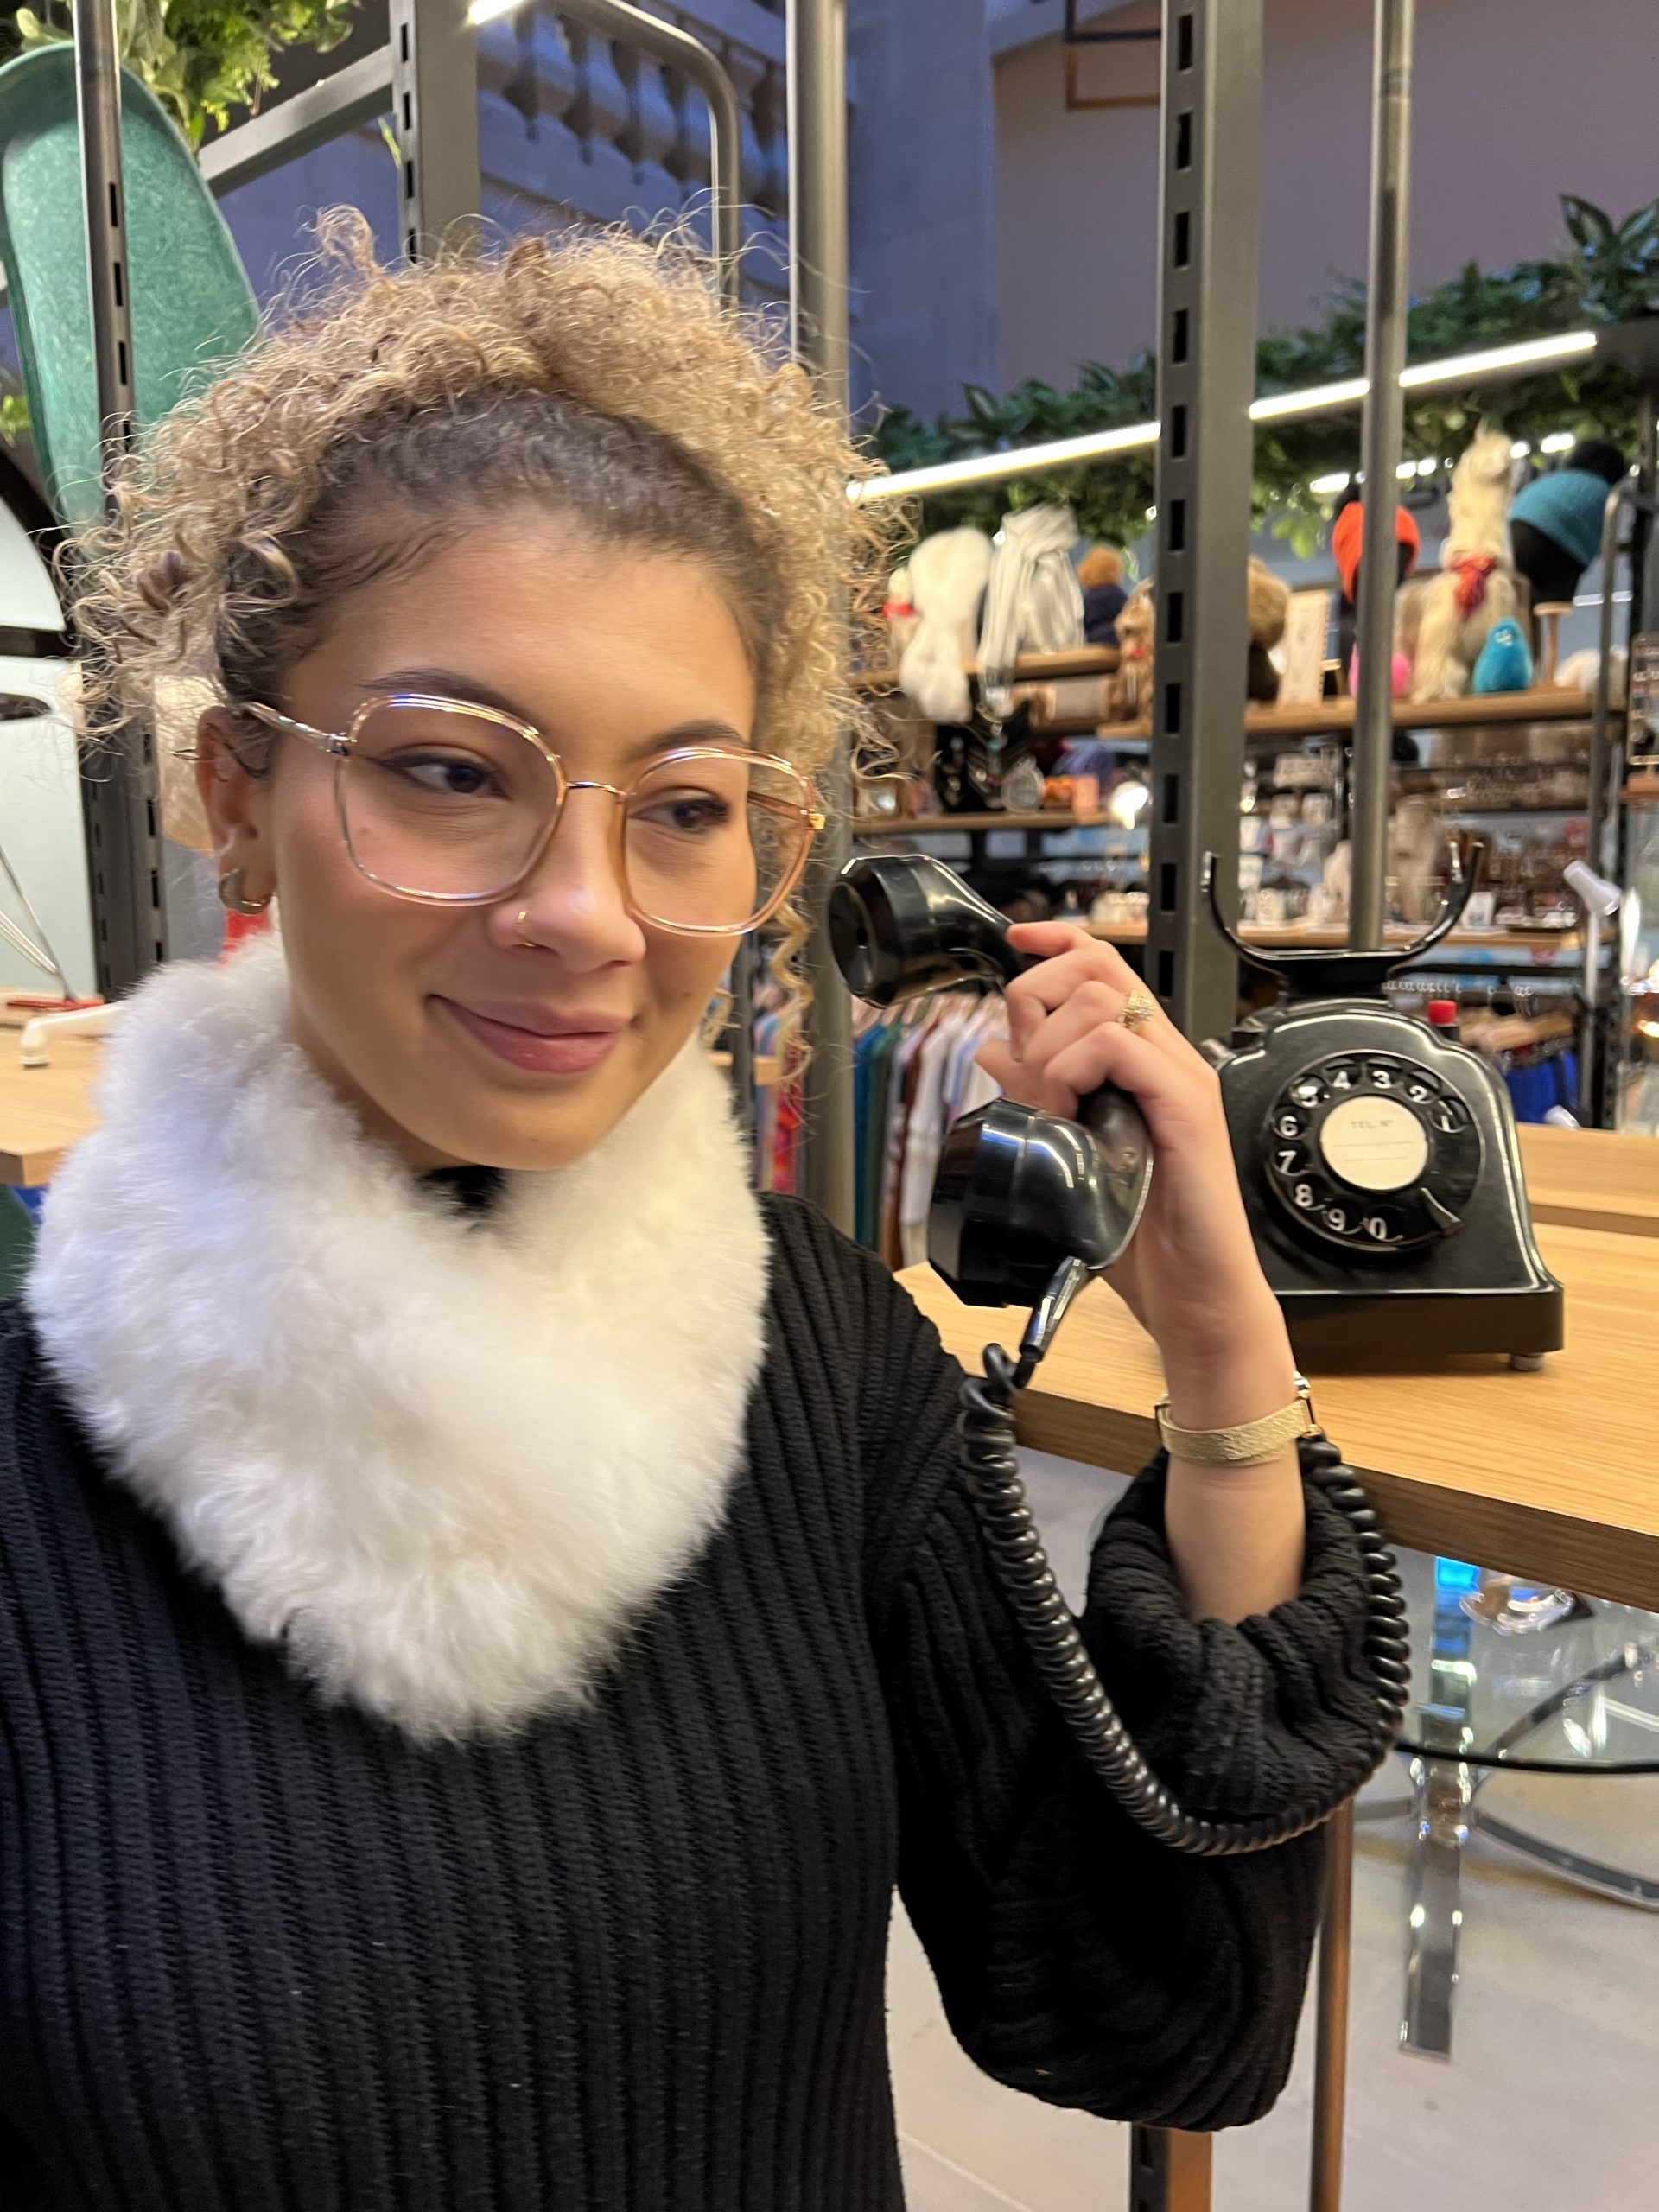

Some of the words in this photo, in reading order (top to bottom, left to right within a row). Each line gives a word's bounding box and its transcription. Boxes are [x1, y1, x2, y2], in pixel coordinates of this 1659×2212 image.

[1333, 1071, 1351, 1089] 4
[1372, 1071, 1391, 1089] 3
[1298, 1085, 1318, 1107] 5
[1409, 1085, 1427, 1103] 2
[1280, 1116, 1298, 1136] 6
[1279, 1150, 1296, 1173] 7
[1295, 1184, 1313, 1207] 8
[1328, 1208, 1345, 1231] 9
[1368, 1217, 1387, 1240] 0
